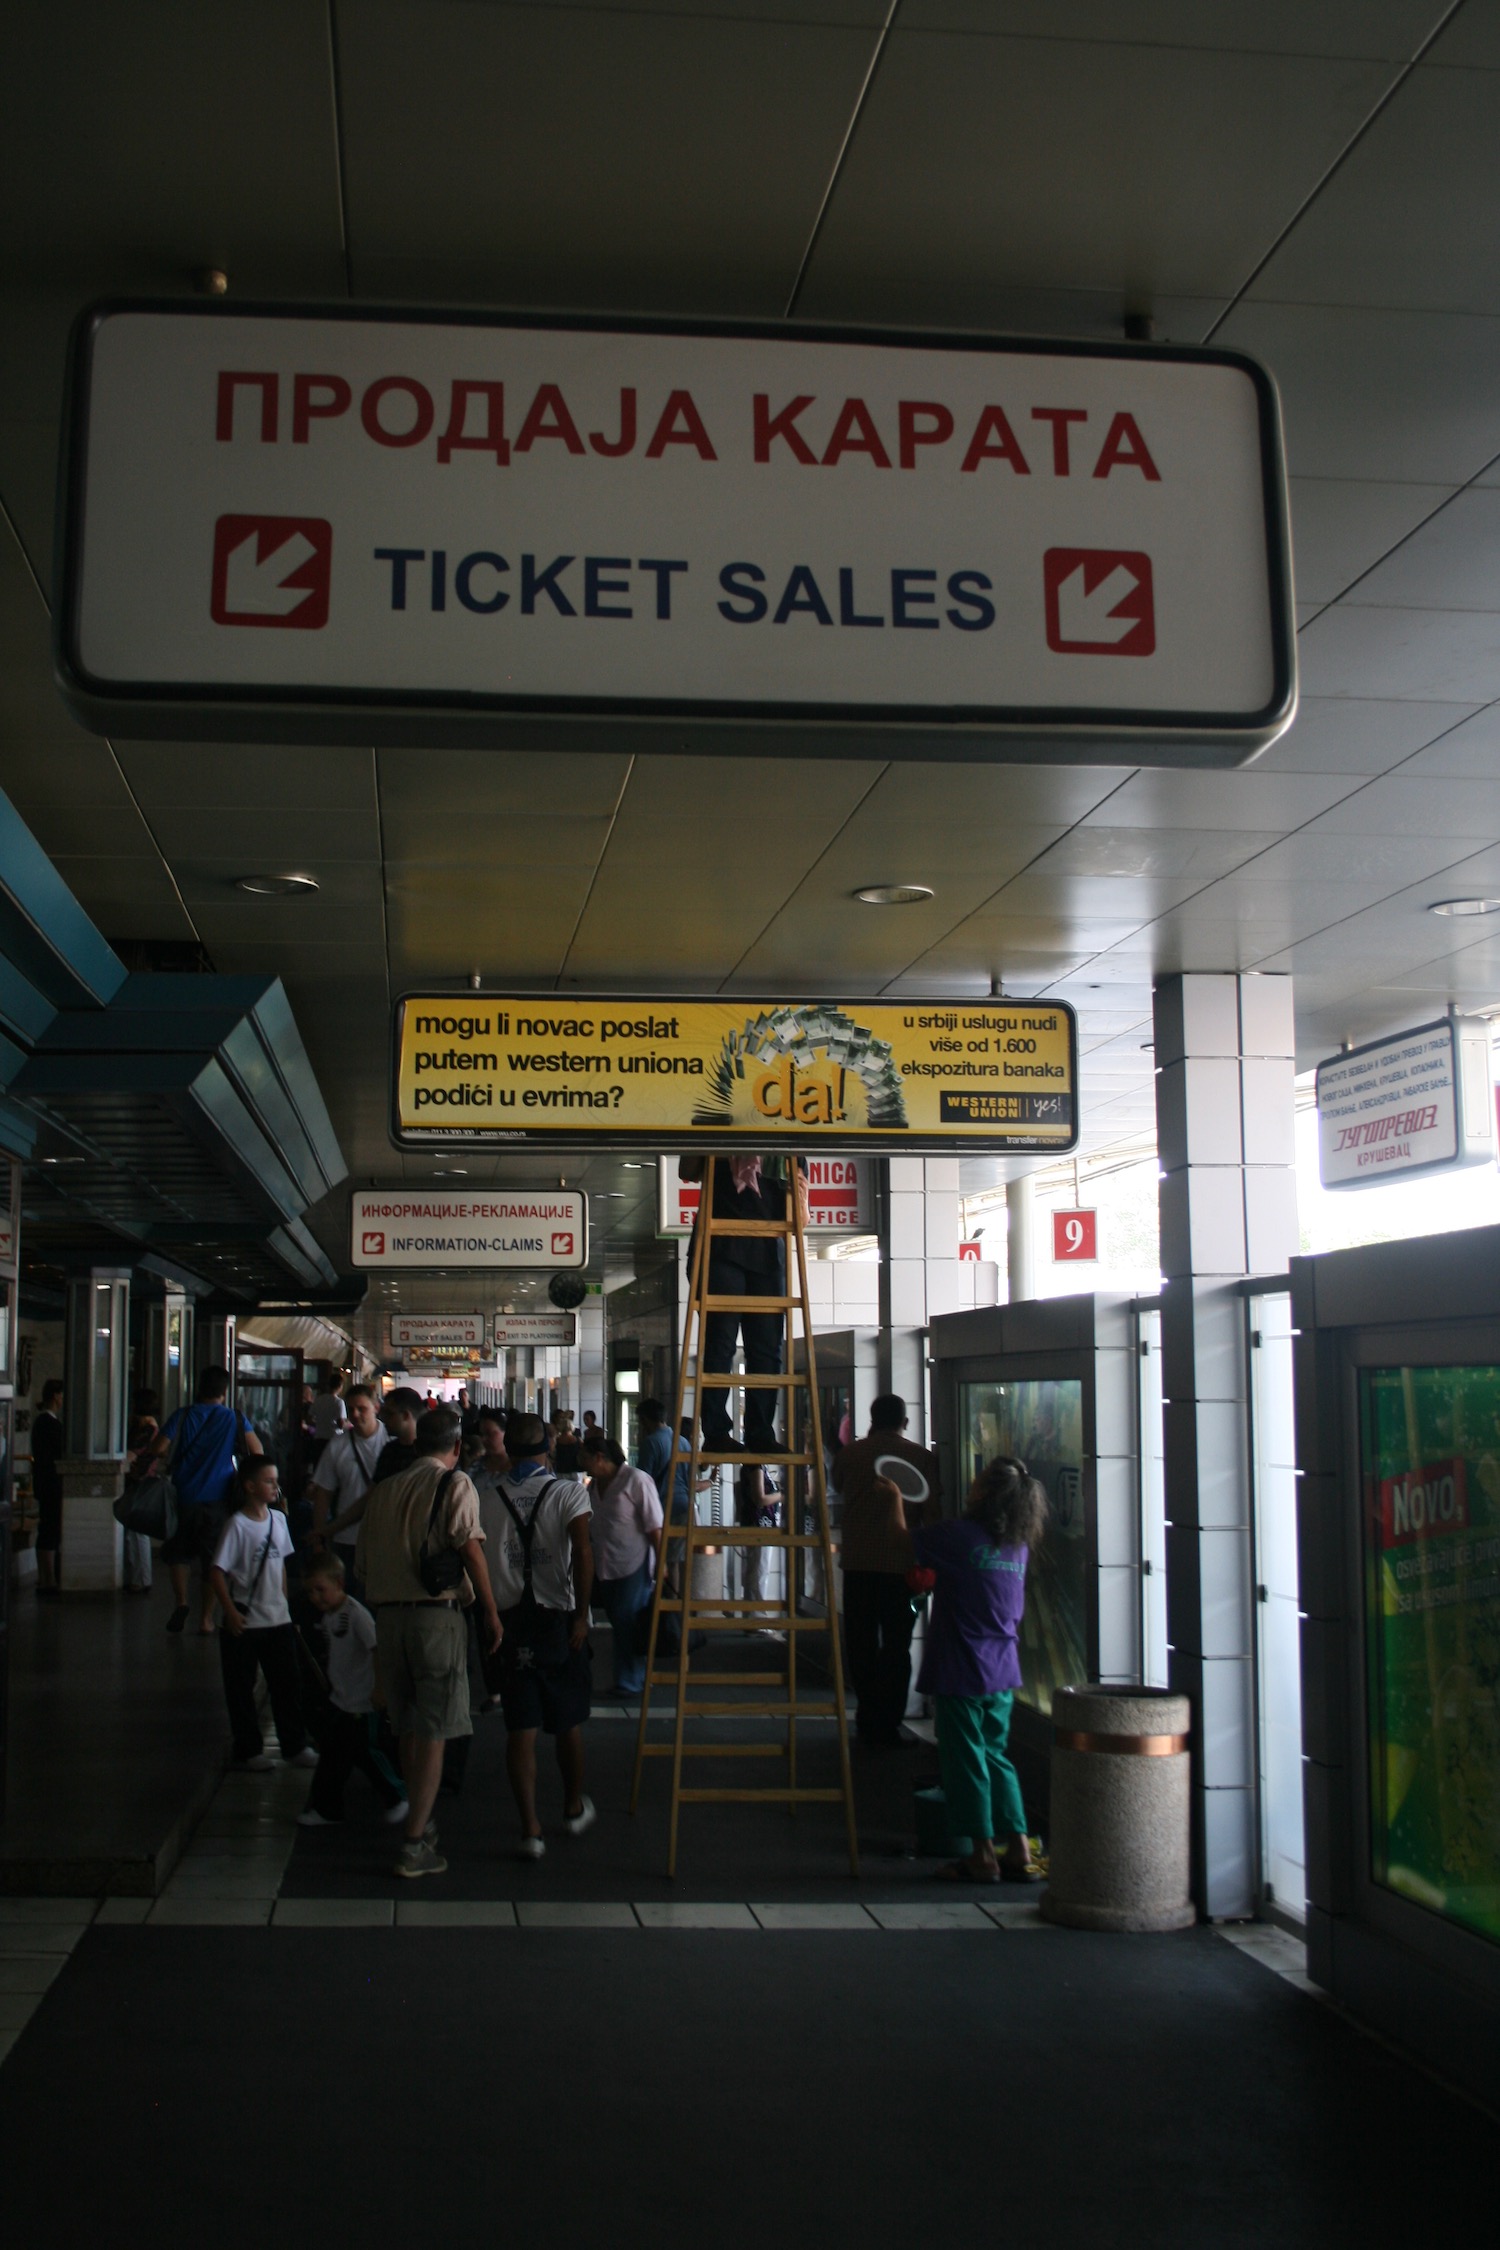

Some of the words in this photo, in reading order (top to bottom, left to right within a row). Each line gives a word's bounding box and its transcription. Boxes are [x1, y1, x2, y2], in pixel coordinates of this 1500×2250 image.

[215, 371, 718, 467] ПРОДАЈА
[753, 394, 1162, 482] КАРАТА
[374, 548, 688, 620] TICKET
[717, 562, 996, 632] SALES
[415, 1016, 490, 1040] mogu
[498, 1013, 510, 1035] li
[516, 1018, 594, 1037] novac
[600, 1016, 679, 1042] poslat
[903, 1015, 914, 1028] u
[918, 1013, 958, 1031] srbiji
[962, 1014, 1017, 1033] uslugu
[1022, 1016, 1058, 1031] nudi
[929, 1038, 963, 1053] više
[967, 1038, 989, 1053] od
[993, 1038, 1036, 1054] 1.600
[414, 1049, 497, 1074] putem
[507, 1050, 611, 1073] western
[618, 1052, 703, 1075] uniona
[901, 1060, 1000, 1079] ekspozitura
[1003, 1061, 1065, 1078] banaka
[414, 1083, 493, 1110] podići
[500, 1090, 515, 1106] u
[522, 1085, 625, 1108] evrima?
[752, 1060, 848, 1124] da!
[946, 1096, 1018, 1108] WESTERN
[969, 1107, 1018, 1118] UNION
[1033, 1096, 1061, 1118] yes!
[1006, 1135, 1038, 1145] transfer
[1357, 1142, 1411, 1167] КРУШЕВАЦ
[361, 1203, 573, 1220] ИНФОРМАЦИЈЕ-РЕКЛАМАЦИЈЕ
[392, 1238, 543, 1251] INFORMATION-CLAIMS
[1065, 1220, 1084, 1252] 9
